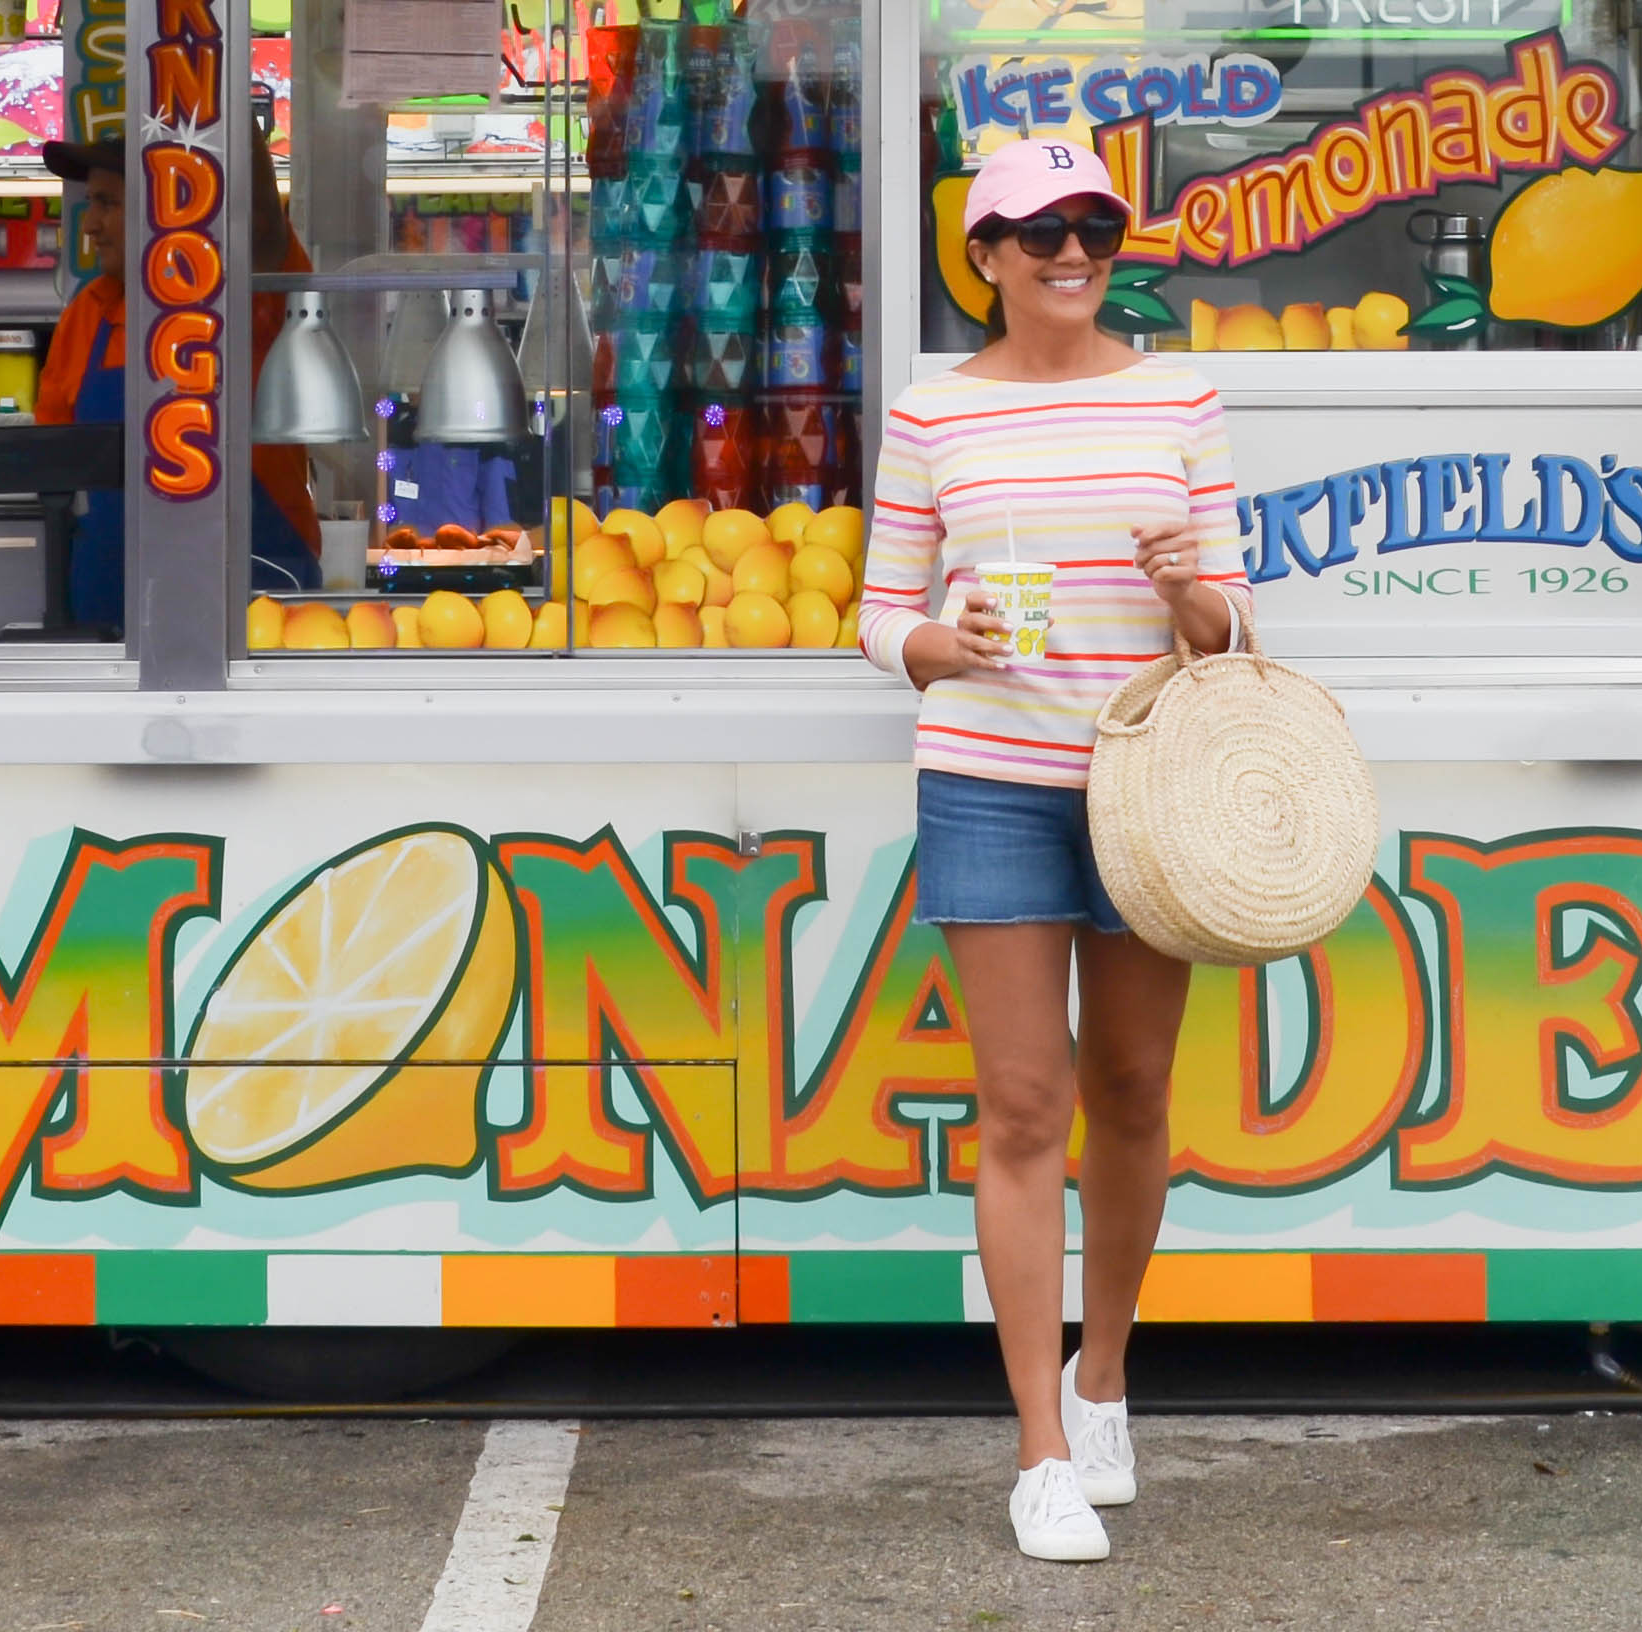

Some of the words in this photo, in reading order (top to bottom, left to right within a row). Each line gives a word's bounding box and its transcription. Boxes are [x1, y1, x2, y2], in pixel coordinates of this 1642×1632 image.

[958, 62, 1071, 129] ICE
[1081, 56, 1283, 124] COLD
[1043, 144, 1075, 171] B
[1095, 29, 1631, 268] Lemonade
[142, 140, 224, 504] DOGS
[1342, 567, 1492, 596] SINCE
[1517, 566, 1630, 594] 1926
